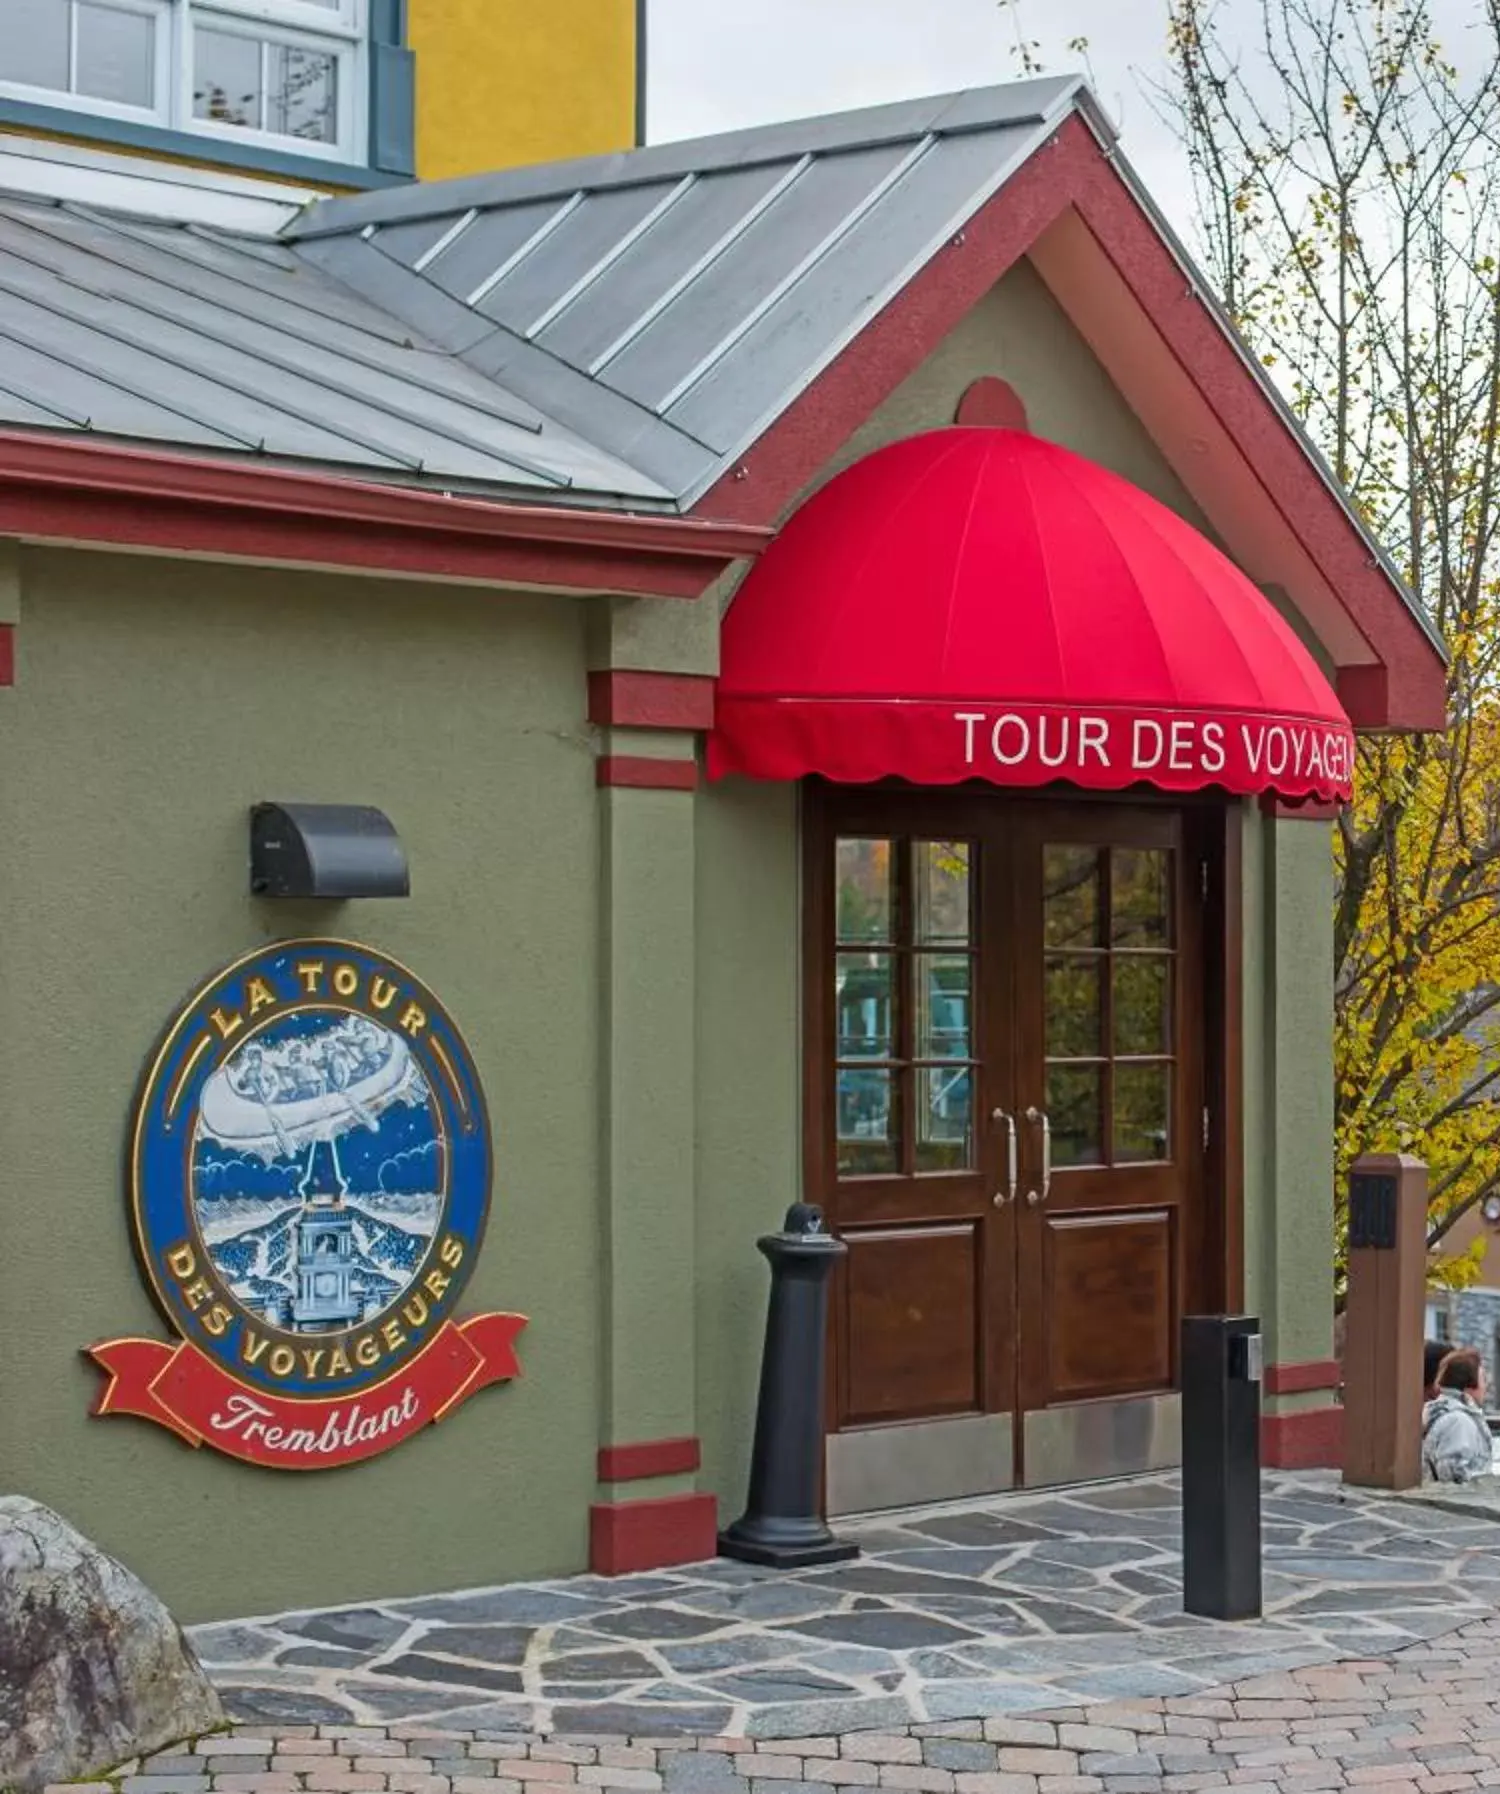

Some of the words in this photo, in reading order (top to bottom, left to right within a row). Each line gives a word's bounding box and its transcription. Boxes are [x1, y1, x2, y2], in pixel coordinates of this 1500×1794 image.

[954, 713, 1110, 767] TOUR
[1132, 720, 1226, 771] DES
[210, 977, 277, 1039] LA
[299, 961, 427, 1038] TOUR
[167, 1243, 235, 1336] DES
[242, 1238, 464, 1379] VOYAGEURS
[209, 1386, 420, 1454] Tremblant
